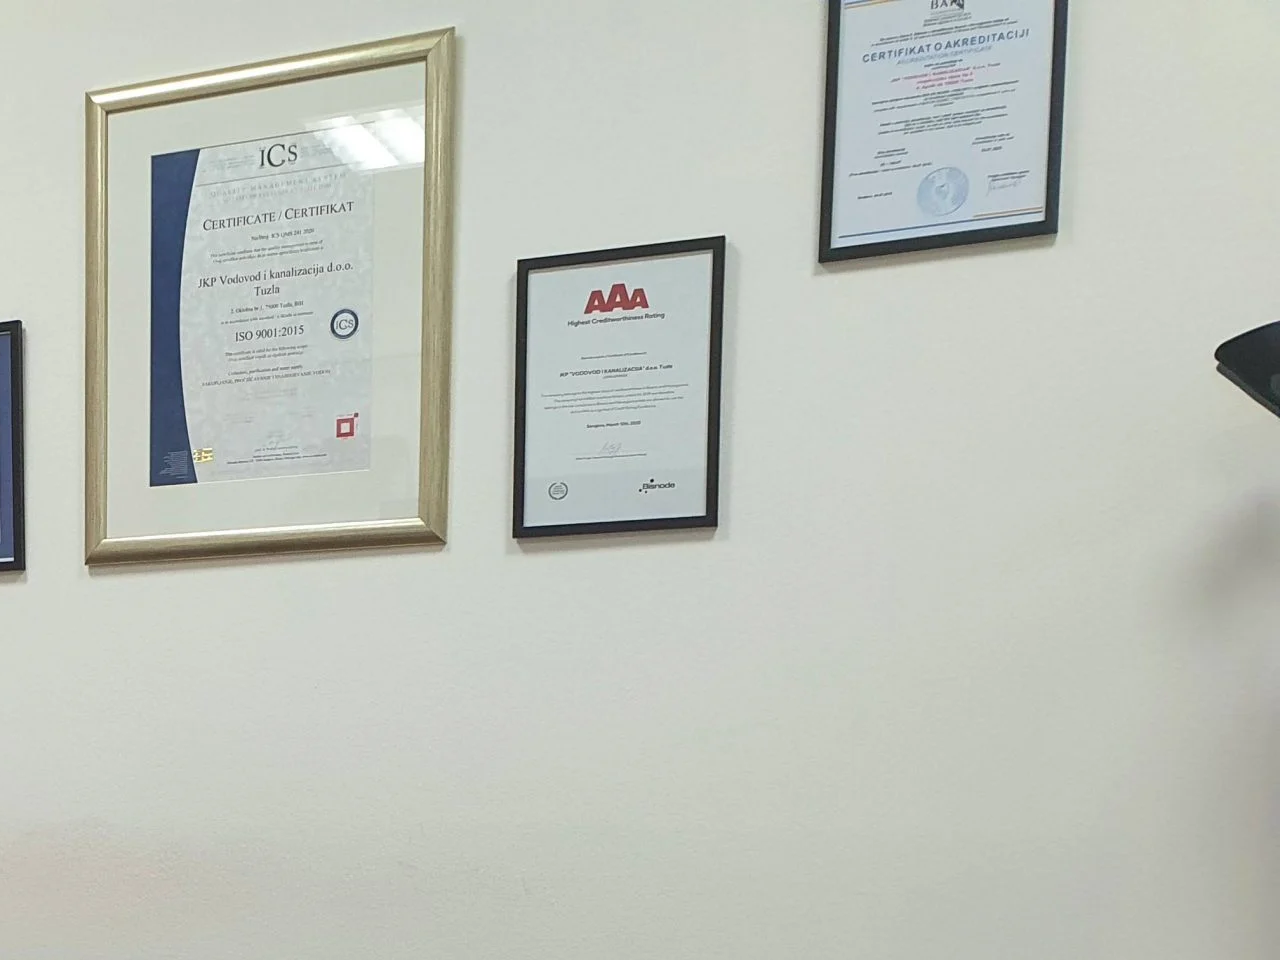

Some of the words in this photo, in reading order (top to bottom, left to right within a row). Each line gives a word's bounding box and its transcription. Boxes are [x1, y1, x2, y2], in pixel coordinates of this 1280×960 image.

[862, 44, 932, 63] CERTIFIKAT
[934, 42, 942, 51] O
[944, 29, 1030, 49] AKREDITACIJI
[259, 143, 298, 168] ICS
[202, 211, 276, 231] CERTIFICATE
[284, 201, 355, 220] CERTIFIKAT
[198, 277, 217, 289] JKP
[219, 271, 261, 285] Vodovod
[263, 270, 267, 280] i
[269, 264, 324, 279] kanalizacija
[326, 261, 354, 273] d.o.o.
[254, 284, 280, 297] Tuzla
[584, 283, 650, 314] AAA
[567, 319, 591, 327] Highest
[591, 315, 644, 325] Creditworthiness
[644, 312, 665, 320] Rating
[235, 330, 253, 342] ISO
[255, 324, 305, 340] 9001:2015
[642, 482, 675, 490] Bisnode
